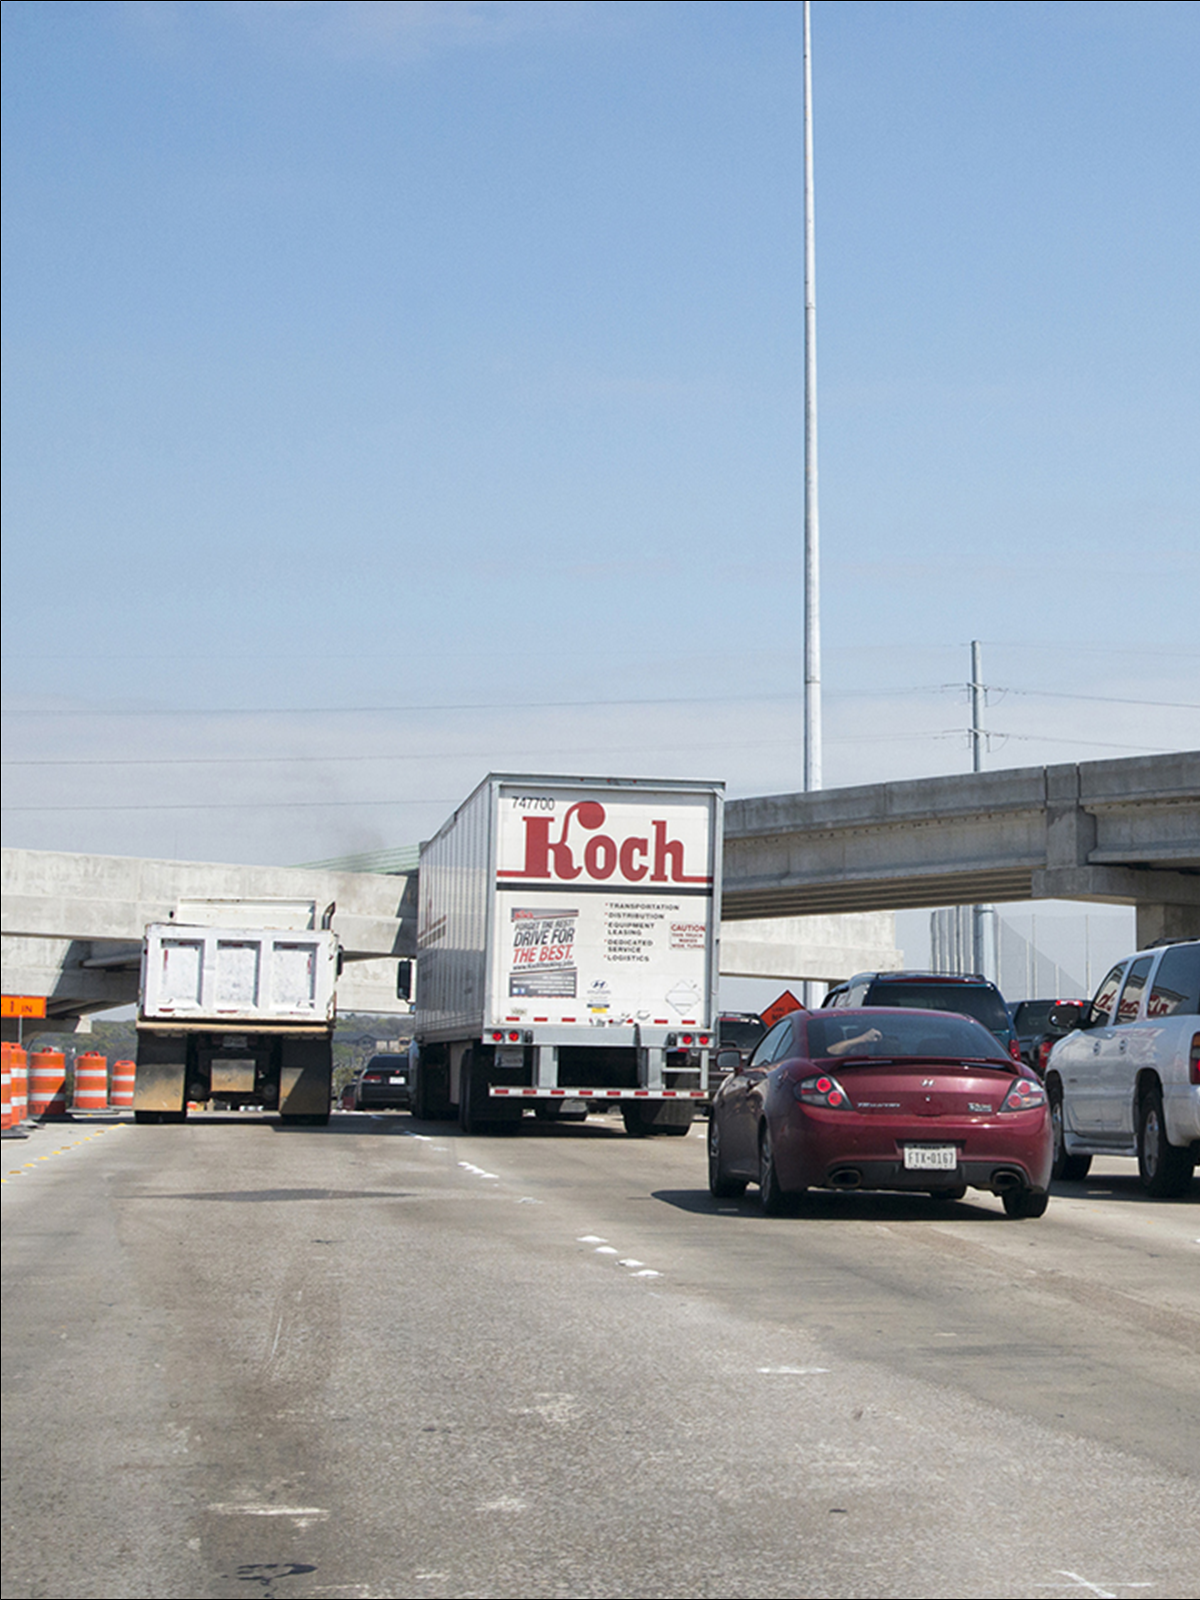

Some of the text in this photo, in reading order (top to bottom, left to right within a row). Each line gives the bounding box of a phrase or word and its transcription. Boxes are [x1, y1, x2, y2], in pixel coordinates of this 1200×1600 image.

[512, 796, 555, 811] 747700
[522, 801, 684, 883] Koch
[609, 902, 680, 911] TRANSPORTATION
[608, 912, 665, 920] DISTRIBUTION
[671, 923, 706, 933] CAUTION
[513, 927, 576, 947] DRIVE FOR
[607, 939, 654, 947] DEDICATED
[513, 944, 574, 964] THE BEST.
[607, 954, 650, 962] LOGISTICS
